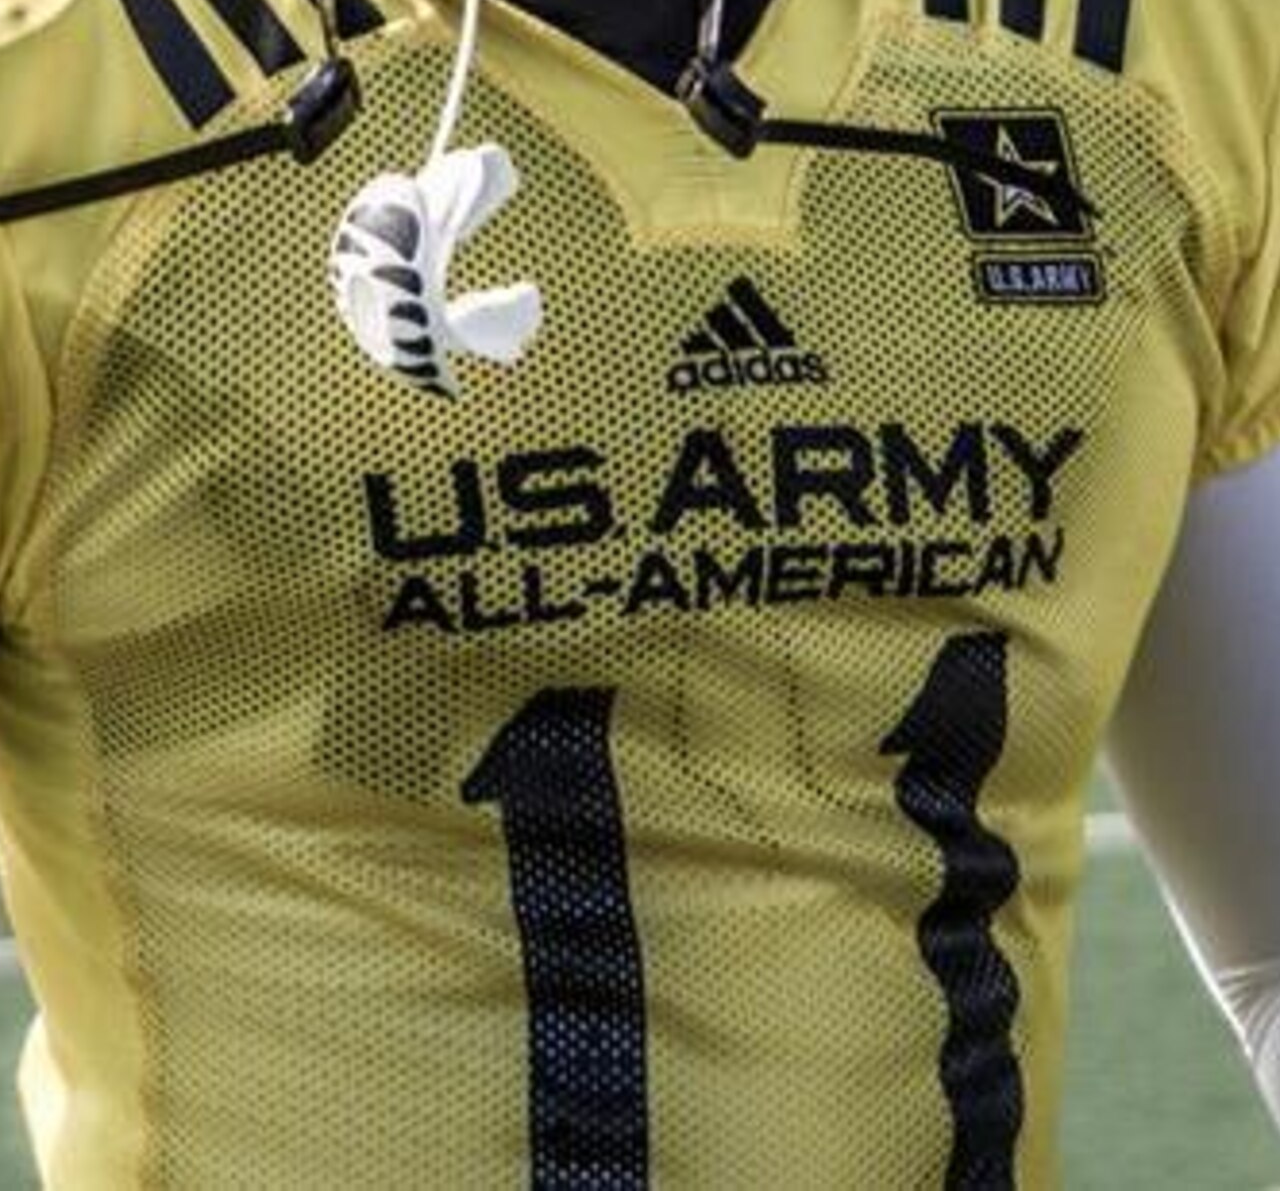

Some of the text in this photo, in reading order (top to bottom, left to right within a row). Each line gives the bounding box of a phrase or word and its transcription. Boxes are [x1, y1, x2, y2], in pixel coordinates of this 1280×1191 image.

[668, 349, 827, 390] adidas
[654, 422, 1084, 531] ARMY
[381, 528, 1064, 632] ALL-AMERICAN
